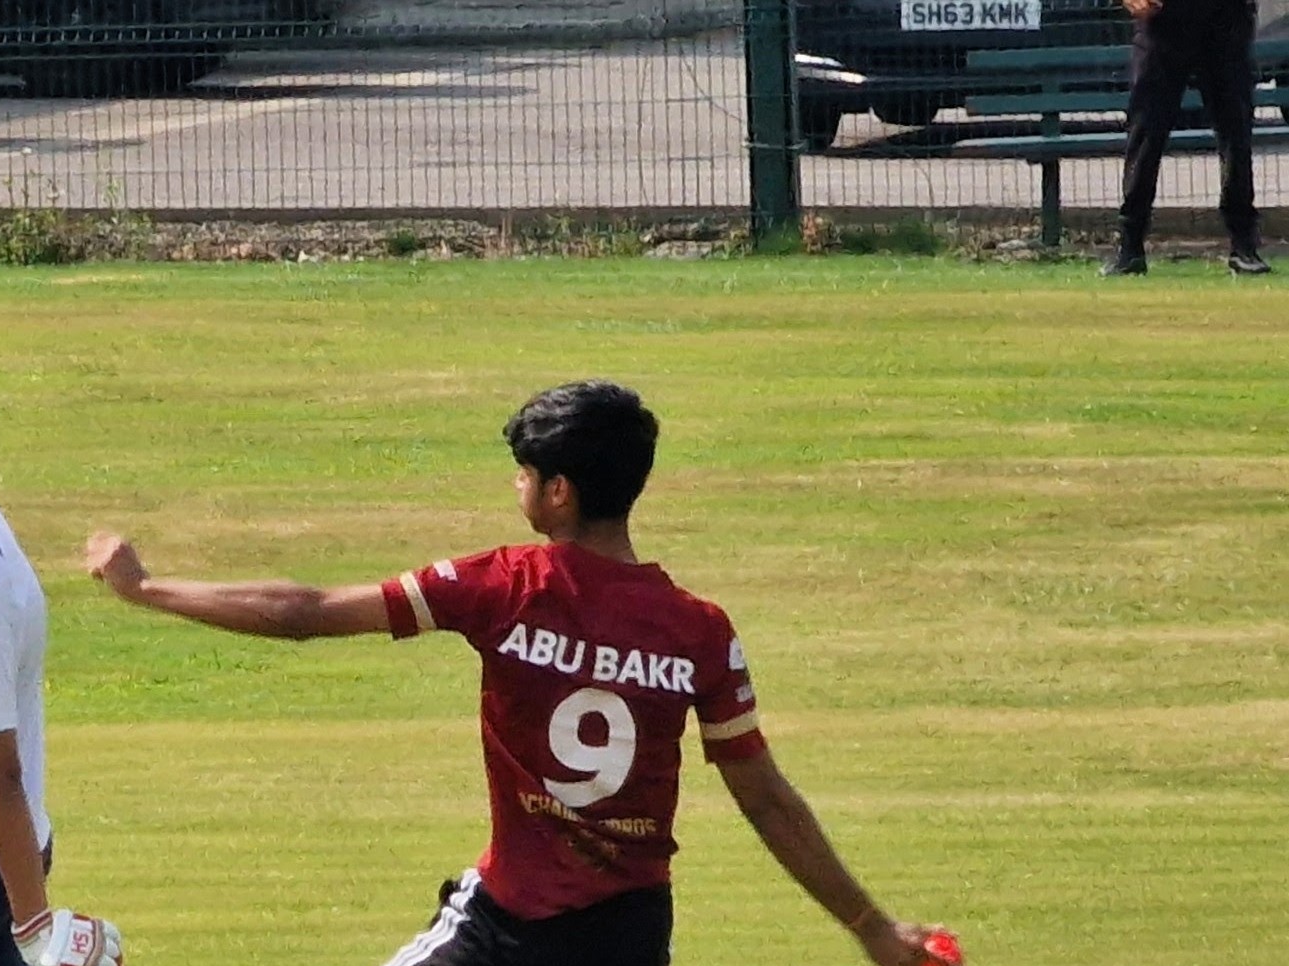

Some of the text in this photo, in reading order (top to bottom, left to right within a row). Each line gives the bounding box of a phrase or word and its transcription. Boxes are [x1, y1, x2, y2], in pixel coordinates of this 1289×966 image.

[912, 1, 1029, 26] SH63 KMK
[497, 623, 696, 695] ABU BAKR
[543, 687, 637, 809] 9
